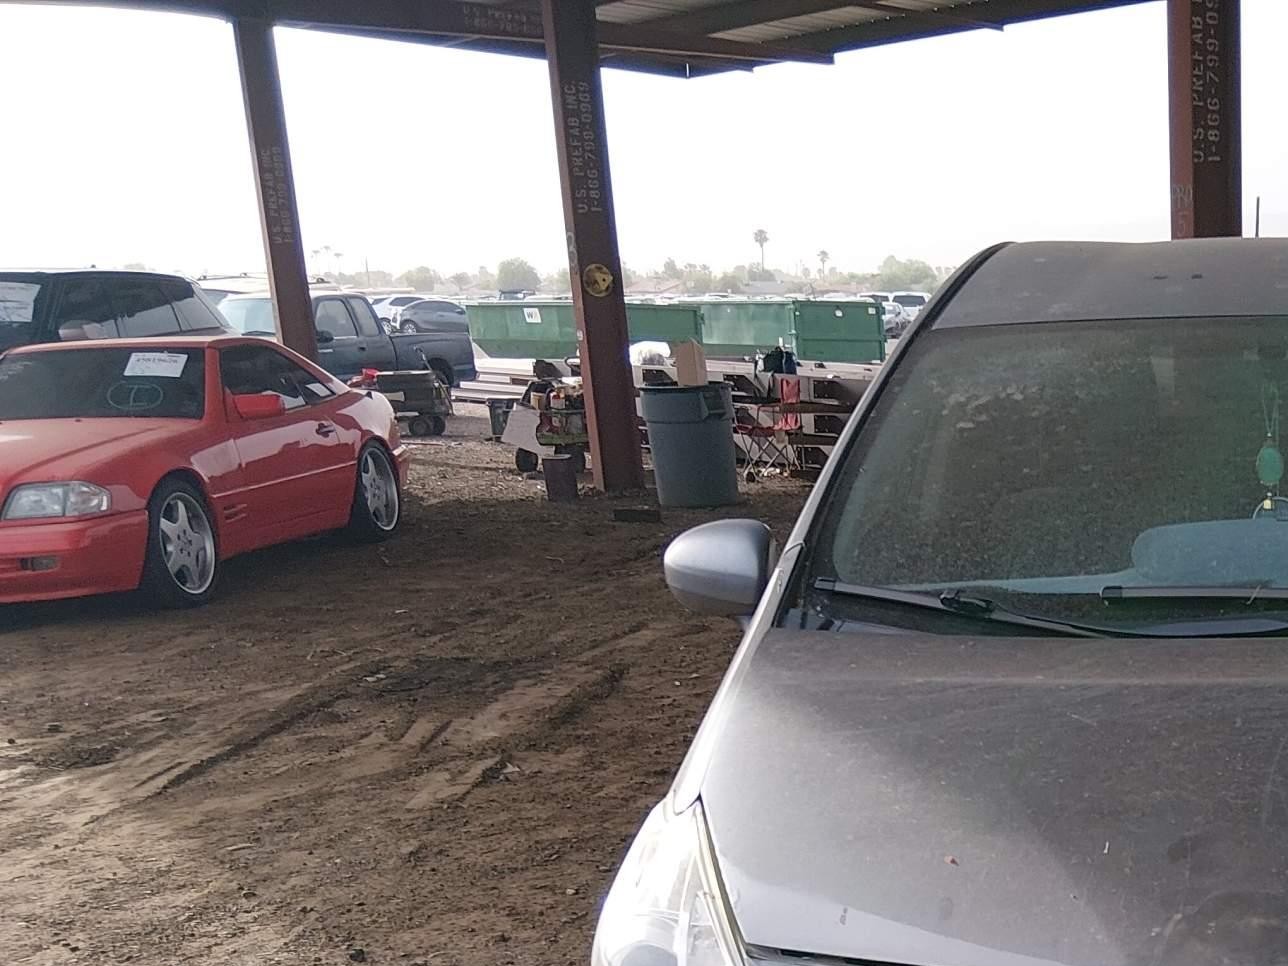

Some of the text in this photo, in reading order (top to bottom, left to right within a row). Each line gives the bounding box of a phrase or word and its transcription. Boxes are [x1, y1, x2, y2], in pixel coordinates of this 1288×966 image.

[1191, 16, 1204, 107] PREFAB
[567, 117, 585, 176] PREFAB
[1193, 120, 1205, 163] U.S.
[575, 184, 588, 214] U.S.
